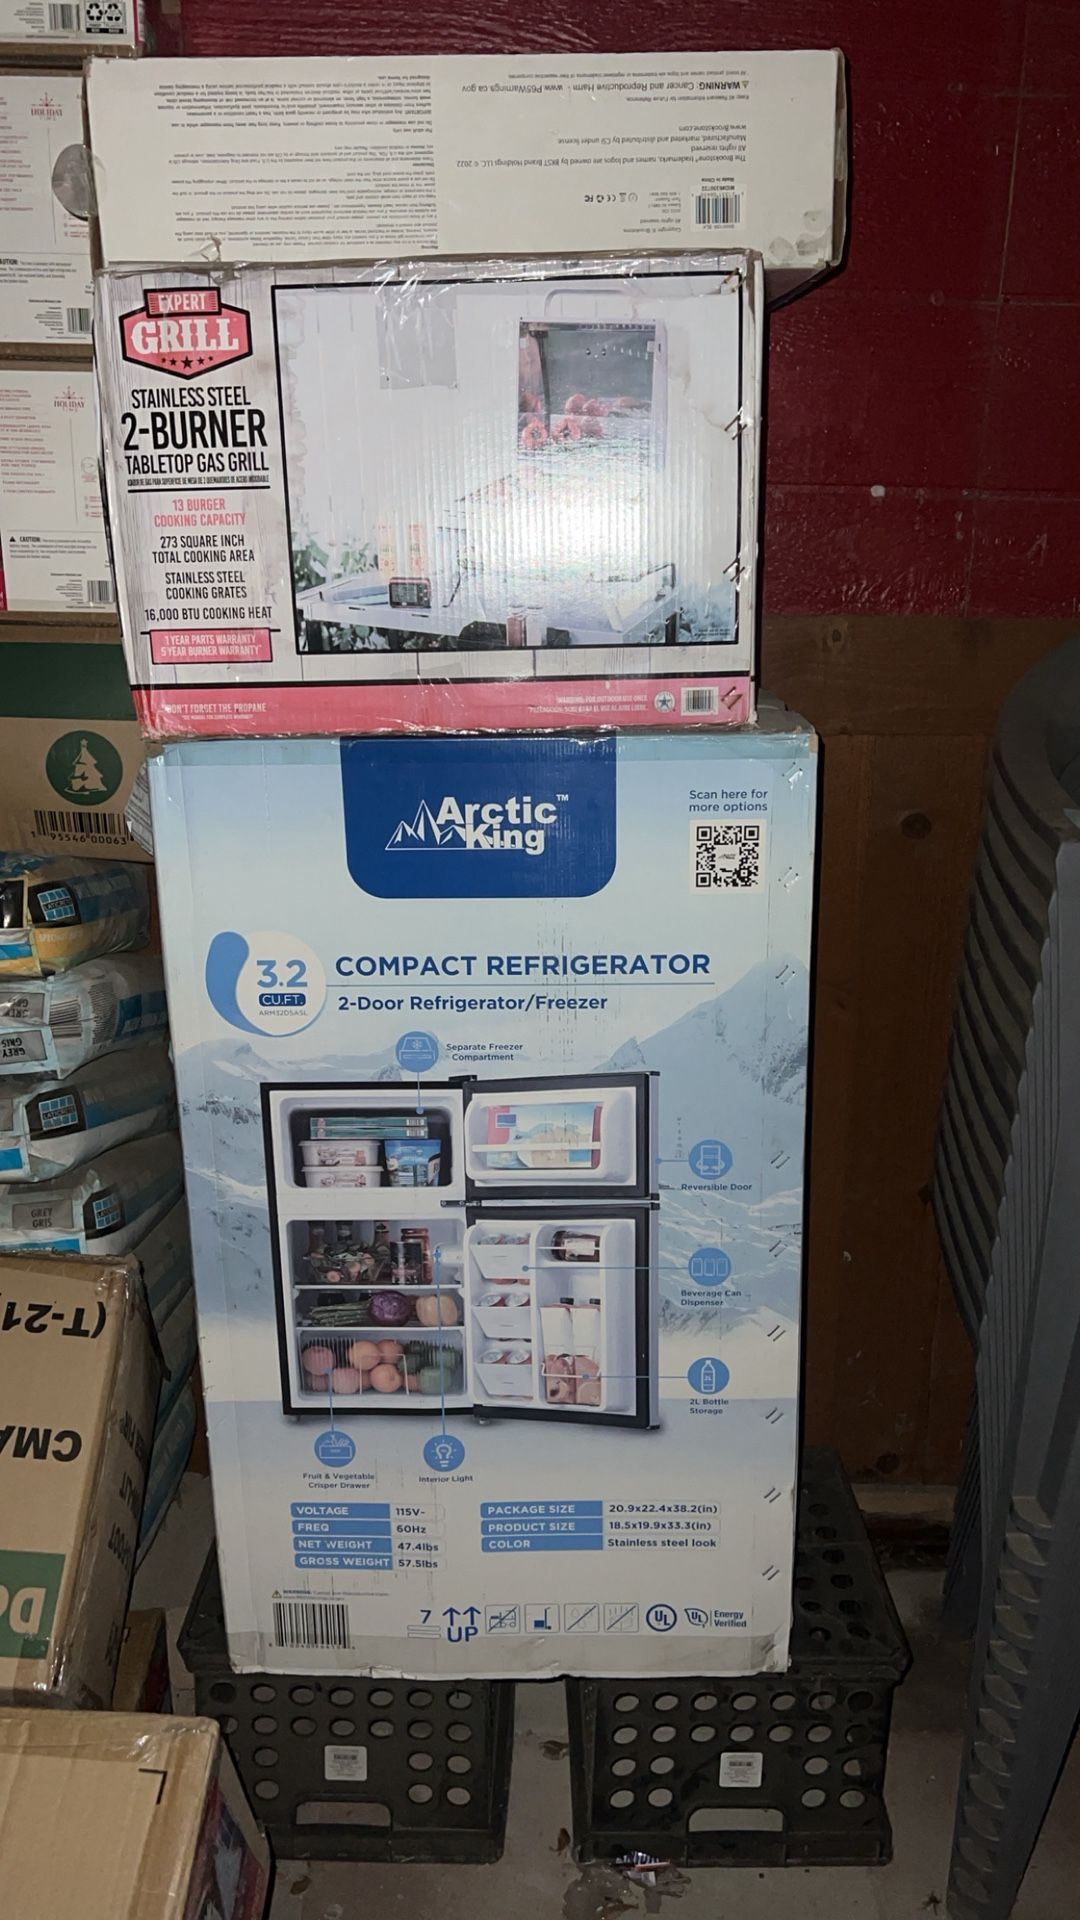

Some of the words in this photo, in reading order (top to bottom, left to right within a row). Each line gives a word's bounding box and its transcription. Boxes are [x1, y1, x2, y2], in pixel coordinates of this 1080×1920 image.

[573, 84, 594, 92] Harm
[597, 83, 647, 92] Reproductive
[650, 82, 664, 90] and
[667, 82, 694, 90] Cancer
[696, 81, 740, 90] WARNING:
[612, 136, 620, 144] by
[719, 144, 736, 152] rights
[495, 158, 522, 167] Holdings
[604, 157, 620, 165] logos
[158, 293, 207, 311] EXPERT
[130, 318, 239, 355] GRILL
[132, 388, 204, 408] STAINLESS
[207, 386, 251, 406] STEEL
[53, 400, 85, 408] HOLIDAY
[121, 409, 268, 451] 2-BURNER
[125, 454, 194, 475] TABLETOP
[198, 453, 225, 472] GAS
[228, 452, 269, 471] GRILL
[172, 499, 184, 511] 13
[187, 498, 226, 510] BURGER
[154, 514, 197, 527] COOKING
[200, 513, 245, 526] CAPACITY
[160, 536, 178, 548] 273
[181, 535, 218, 548] SQUARE
[221, 535, 245, 547] INCH
[152, 552, 181, 563] TOTAL
[184, 551, 227, 562] COOKING
[229, 549, 255, 562] AREA
[165, 572, 215, 584] STAINLESS
[217, 571, 245, 583] STEEL
[166, 587, 209, 599] COOKING
[212, 587, 248, 599] GRATES
[145, 609, 179, 622] 16,000
[182, 608, 200, 620] BTU
[202, 608, 246, 619] COOKING
[248, 606, 272, 619] HEAT
[171, 635, 190, 645] YEAR
[191, 634, 215, 645] PARTS
[216, 633, 256, 644] WARRANTY
[161, 646, 166, 656] 5
[167, 646, 186, 656] YEAR
[188, 645, 218, 656] BURNER
[190, 703, 216, 713] FORGET
[218, 703, 232, 712] THE
[234, 702, 267, 712] PROPANE
[689, 789, 717, 800] Scan
[721, 788, 748, 799] here
[751, 788, 768, 799] for
[436, 796, 557, 825] Arctic
[689, 802, 719, 812] more
[723, 801, 768, 813] options
[50, 832, 87, 843] 95546
[91, 834, 127, 846] 00063
[466, 823, 545, 856] King
[336, 956, 477, 976] COMPACT
[486, 954, 711, 976] REFRIGERATOR
[256, 959, 307, 988] 3.2
[262, 996, 304, 1006] CU.FT.
[338, 996, 404, 1011] 2-Door
[410, 994, 608, 1012] Refrigerator/Freezer
[1, 1037, 22, 1048] GRIS
[446, 1043, 487, 1052] Separate
[489, 1042, 523, 1051] Freezer
[2, 1047, 26, 1058] GREY
[452, 1053, 514, 1062] Compartment
[681, 1183, 728, 1191] Reversible
[730, 1183, 752, 1191] Door
[31, 1207, 53, 1218] GREY
[32, 1218, 53, 1228] GRIS
[0, 1292, 106, 1339] (T-21
[690, 1407, 723, 1415] Storage
[451, 1475, 473, 1483] Light
[308, 1482, 338, 1490] Crisper
[296, 1506, 349, 1515] VOLTAGE
[488, 1505, 545, 1515] PACKAGE
[549, 1504, 576, 1513] SIZE
[609, 1503, 718, 1514] 20.9x22.4x38.2(in)
[298, 1523, 330, 1532] FREQ
[396, 1525, 426, 1534] 60Hz
[488, 1522, 545, 1532] PRODUCT
[549, 1522, 576, 1531] SIZE
[609, 1521, 711, 1531] 18.5x19.9x33.3(in)
[298, 1540, 321, 1550] NET
[325, 1540, 373, 1550] WEIGHT
[397, 1542, 439, 1552] 47.4lbs
[488, 1540, 531, 1549] COLOR
[607, 1538, 658, 1548] Stainless
[661, 1538, 688, 1547] steel
[692, 1538, 716, 1547] look
[299, 1556, 340, 1566] GROSS
[343, 1557, 390, 1567] WEIGHT
[398, 1559, 438, 1569] 57.5lbs
[420, 1609, 432, 1624] 7
[714, 1609, 744, 1620] Energy
[714, 1619, 747, 1628] Verified
[447, 1626, 478, 1643] UP
